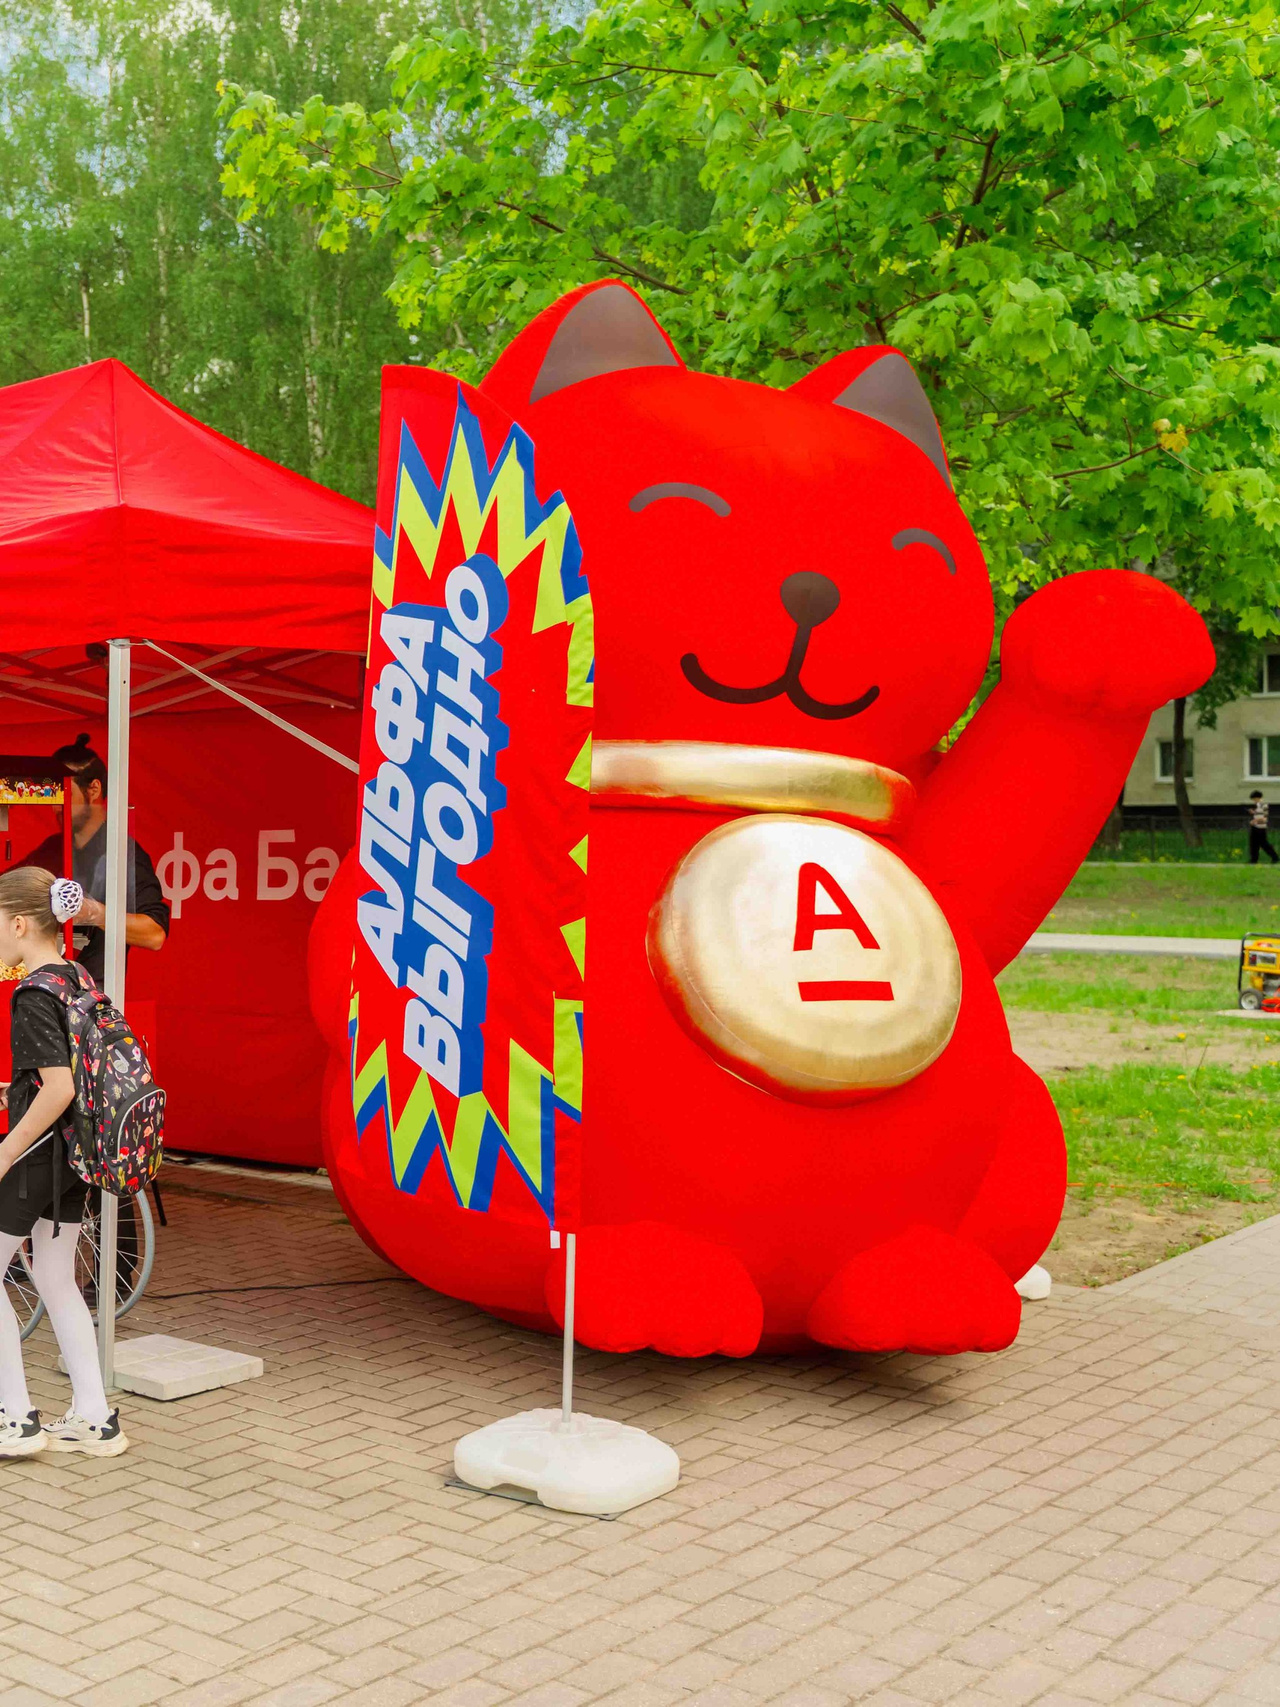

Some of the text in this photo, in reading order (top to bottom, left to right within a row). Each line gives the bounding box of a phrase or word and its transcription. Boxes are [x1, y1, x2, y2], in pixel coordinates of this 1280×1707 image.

[256, 829, 340, 903] Ба
[356, 611, 436, 987] АЛЬФА
[403, 565, 492, 1098] ВЫГОДНО
